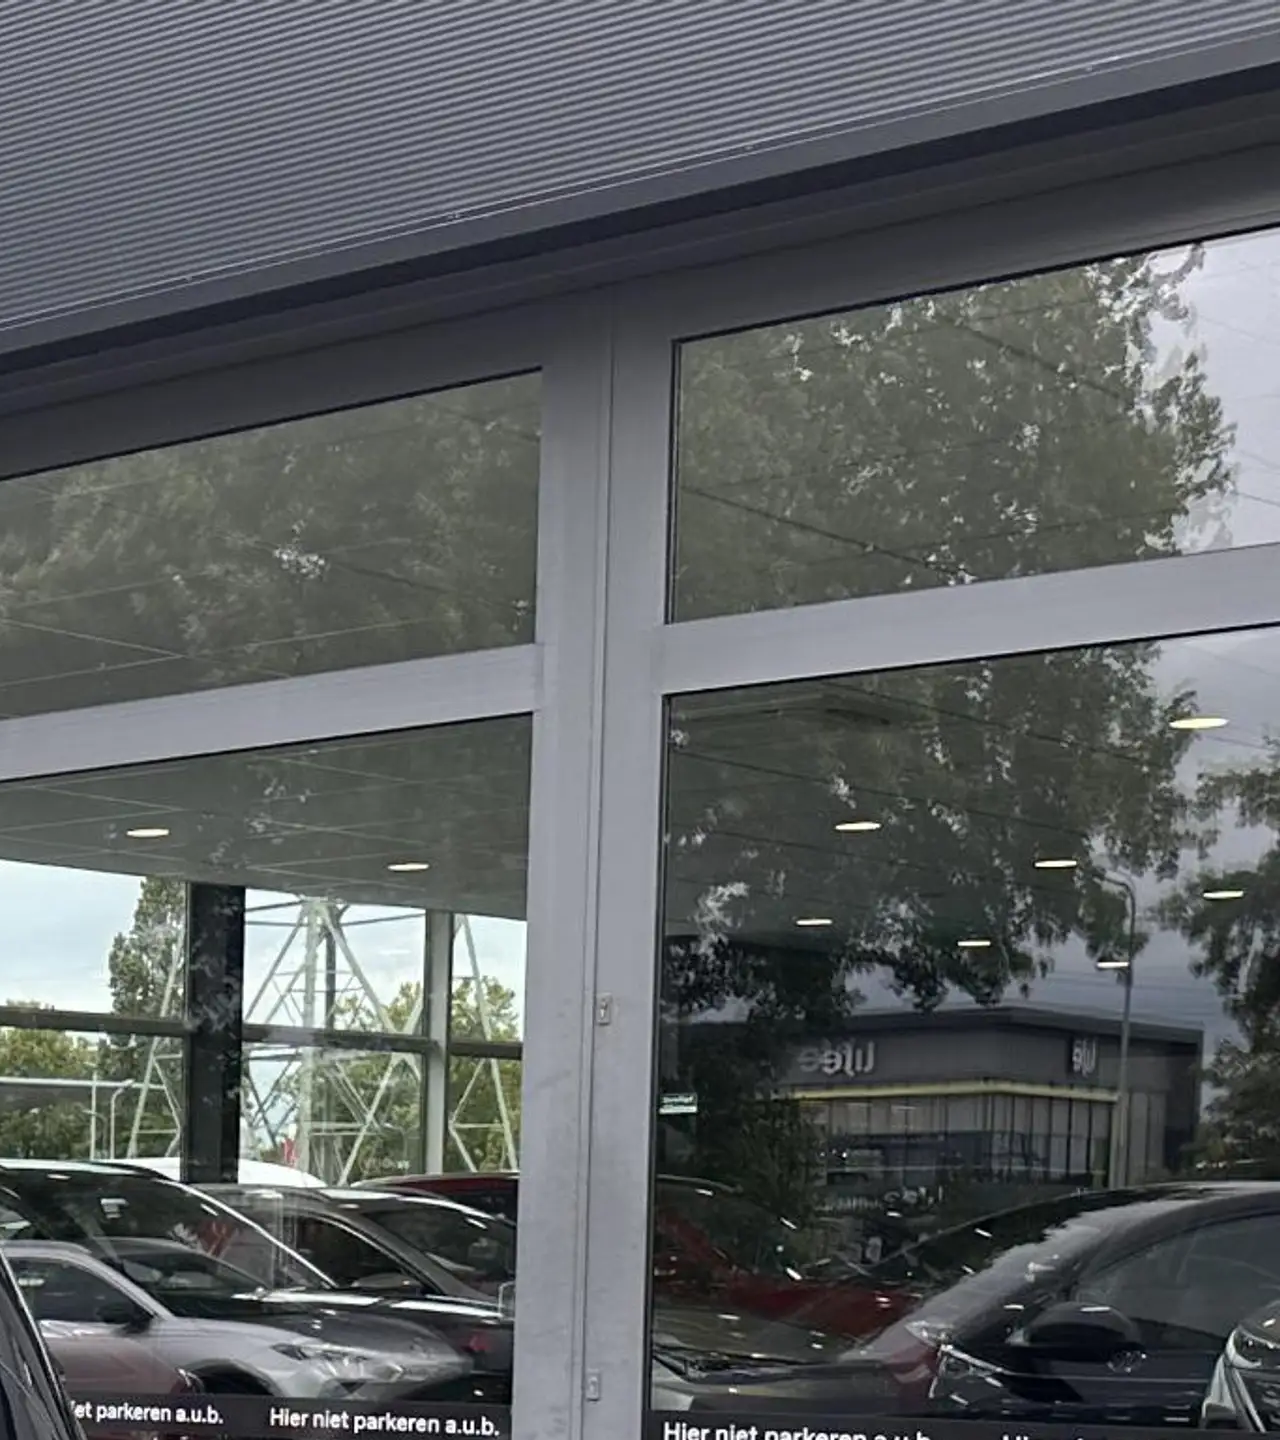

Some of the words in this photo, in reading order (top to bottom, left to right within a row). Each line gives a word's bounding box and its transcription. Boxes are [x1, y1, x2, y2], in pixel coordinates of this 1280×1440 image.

[96, 1402, 172, 1423] parkeren
[175, 1405, 224, 1424] a.u.b.
[270, 1407, 309, 1427] Hier
[312, 1409, 350, 1429] niet
[353, 1411, 440, 1434] parkeren
[445, 1415, 500, 1437] a.u.b.
